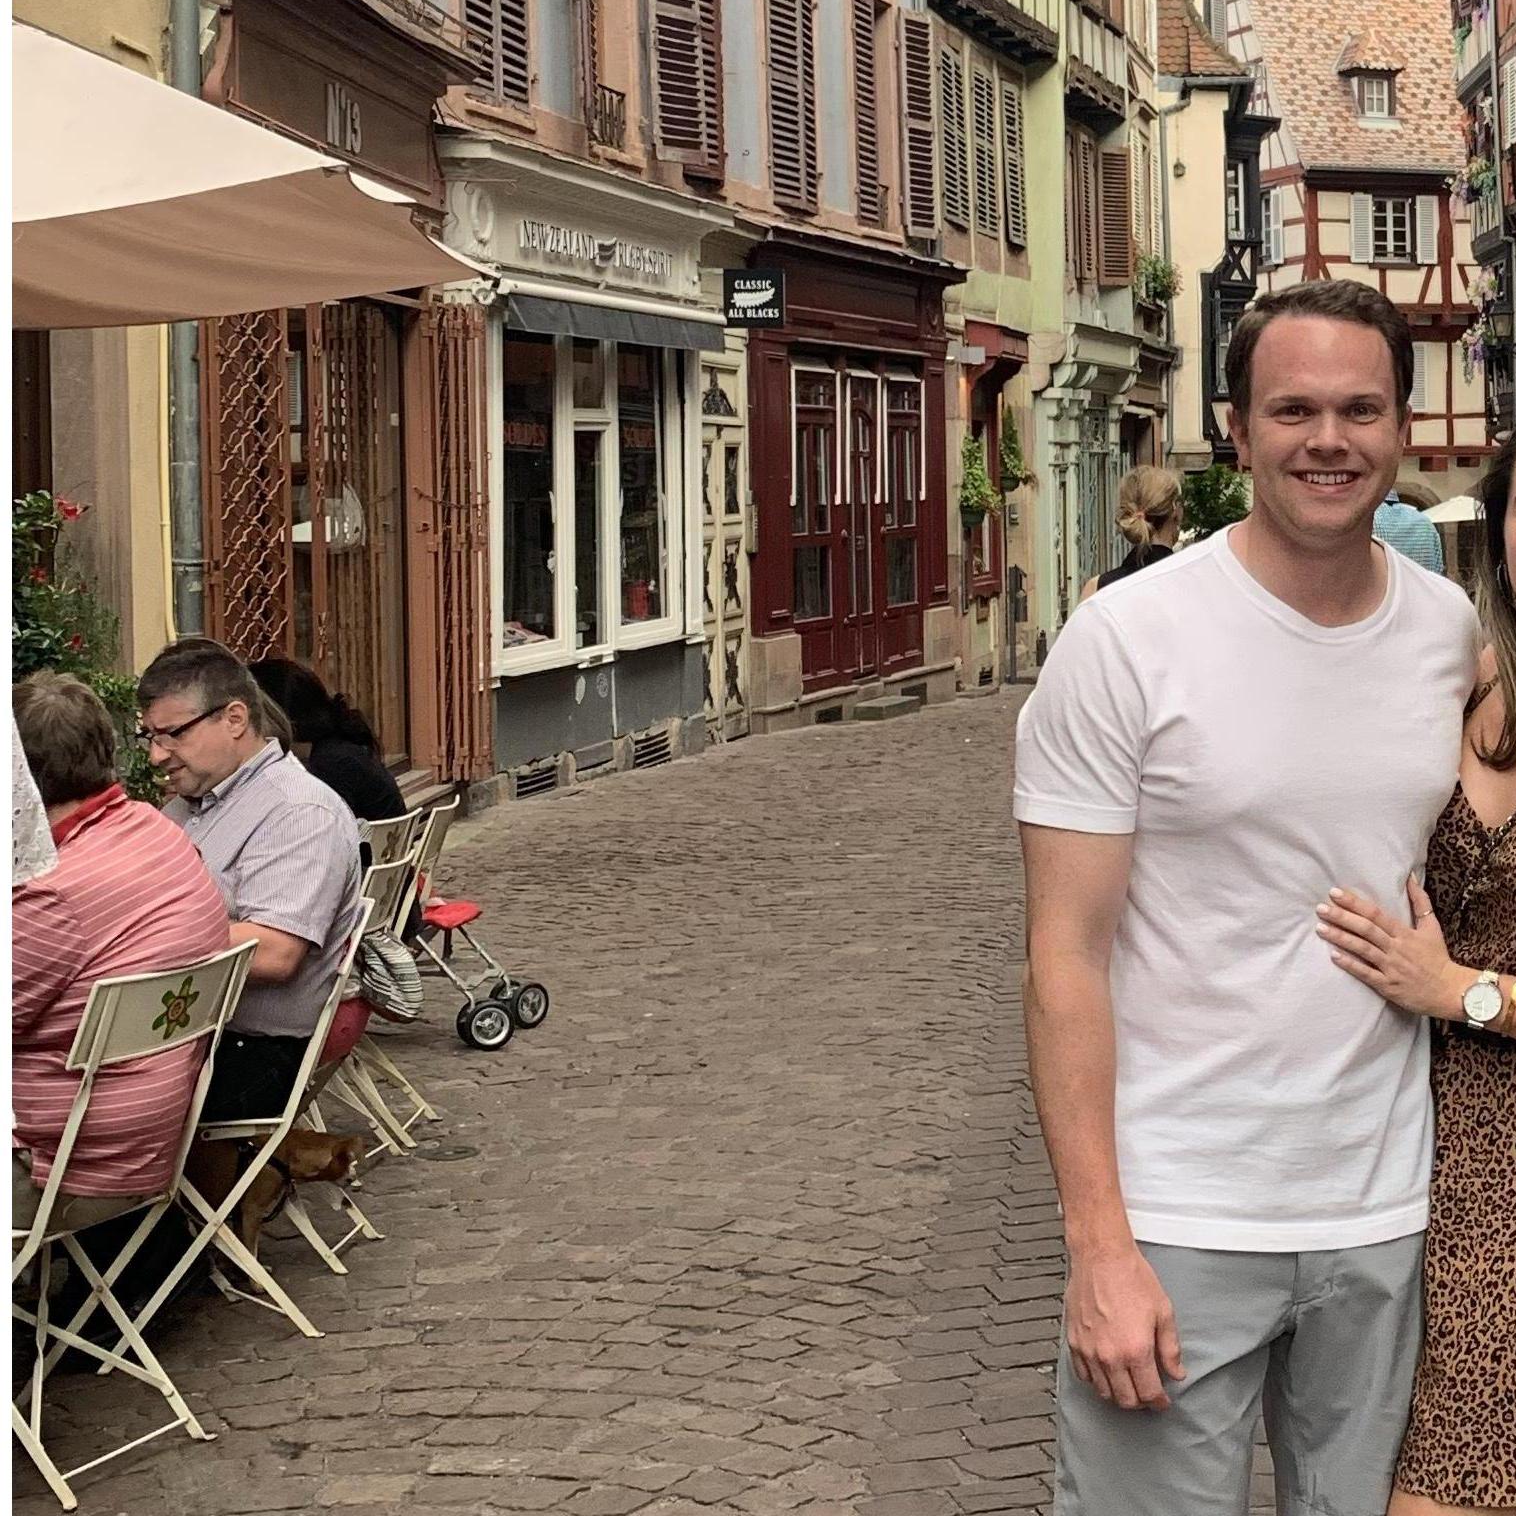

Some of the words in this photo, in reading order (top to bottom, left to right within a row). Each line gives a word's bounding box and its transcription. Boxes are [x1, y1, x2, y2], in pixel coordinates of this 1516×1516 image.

[734, 279, 772, 290] CLASSIC
[728, 308, 744, 318] ALL
[746, 308, 779, 318] BLACKS
